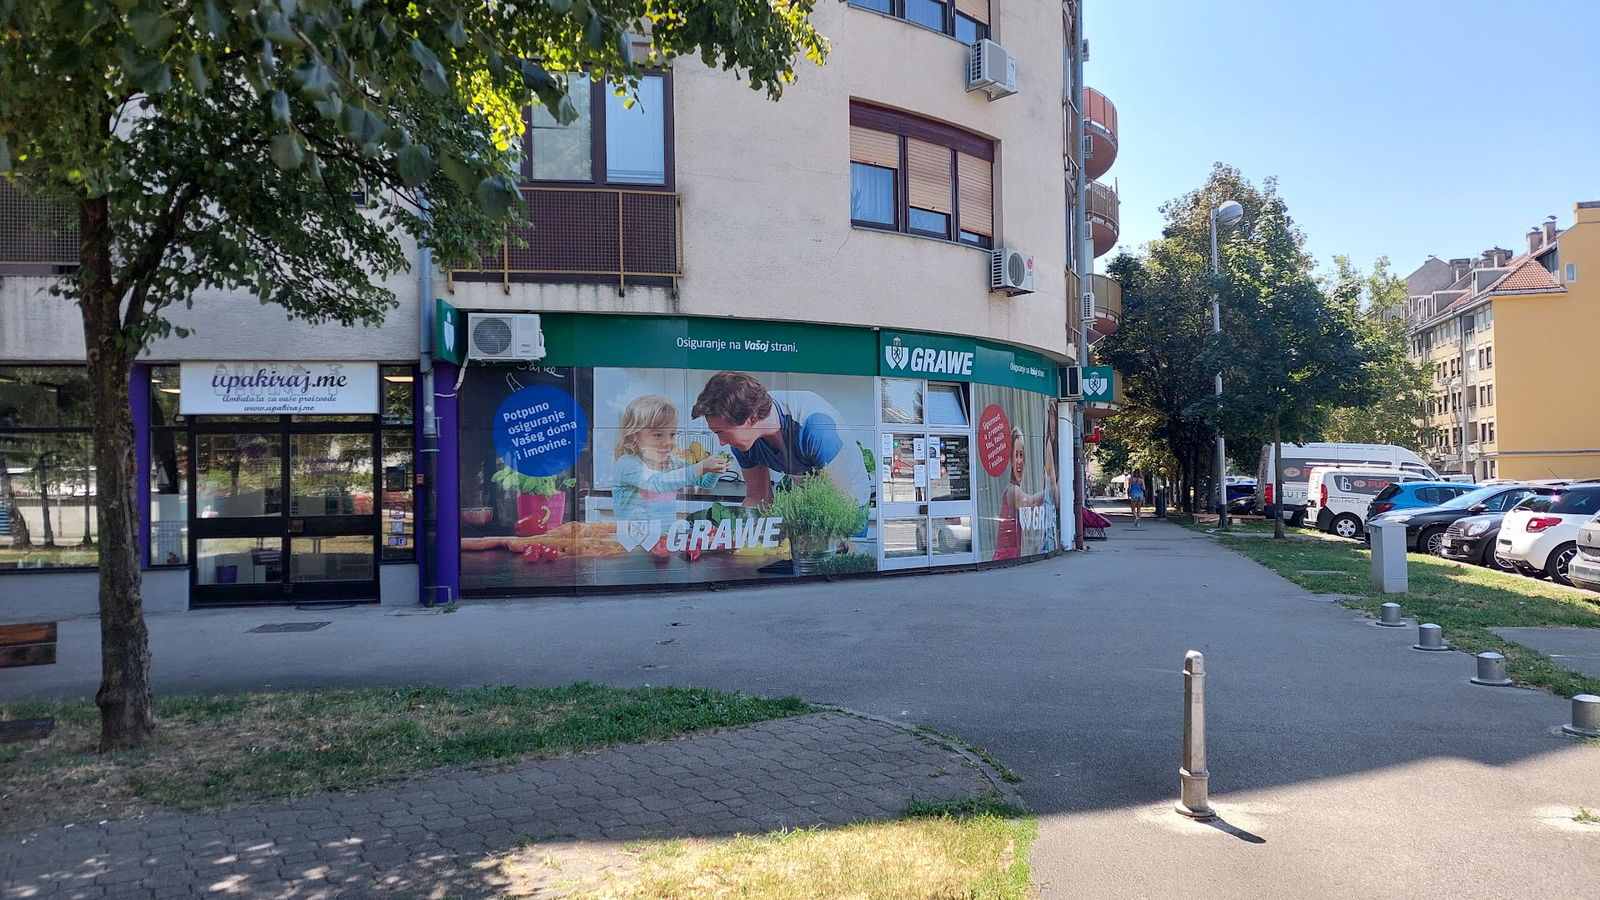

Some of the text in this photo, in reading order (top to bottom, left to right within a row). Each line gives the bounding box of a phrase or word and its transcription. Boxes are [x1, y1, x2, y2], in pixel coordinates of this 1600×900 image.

[676, 337, 798, 353] Osiguranje na Vašoj strani.
[910, 347, 974, 376] GRAWE
[211, 368, 348, 394] upakiraj.me
[298, 395, 337, 403] proizvode
[503, 402, 550, 422] Potpuno
[508, 410, 566, 435] osiguranje
[511, 421, 577, 447] Vašeg doma
[516, 437, 571, 460] i imovine.
[666, 516, 783, 552] GRAWE
